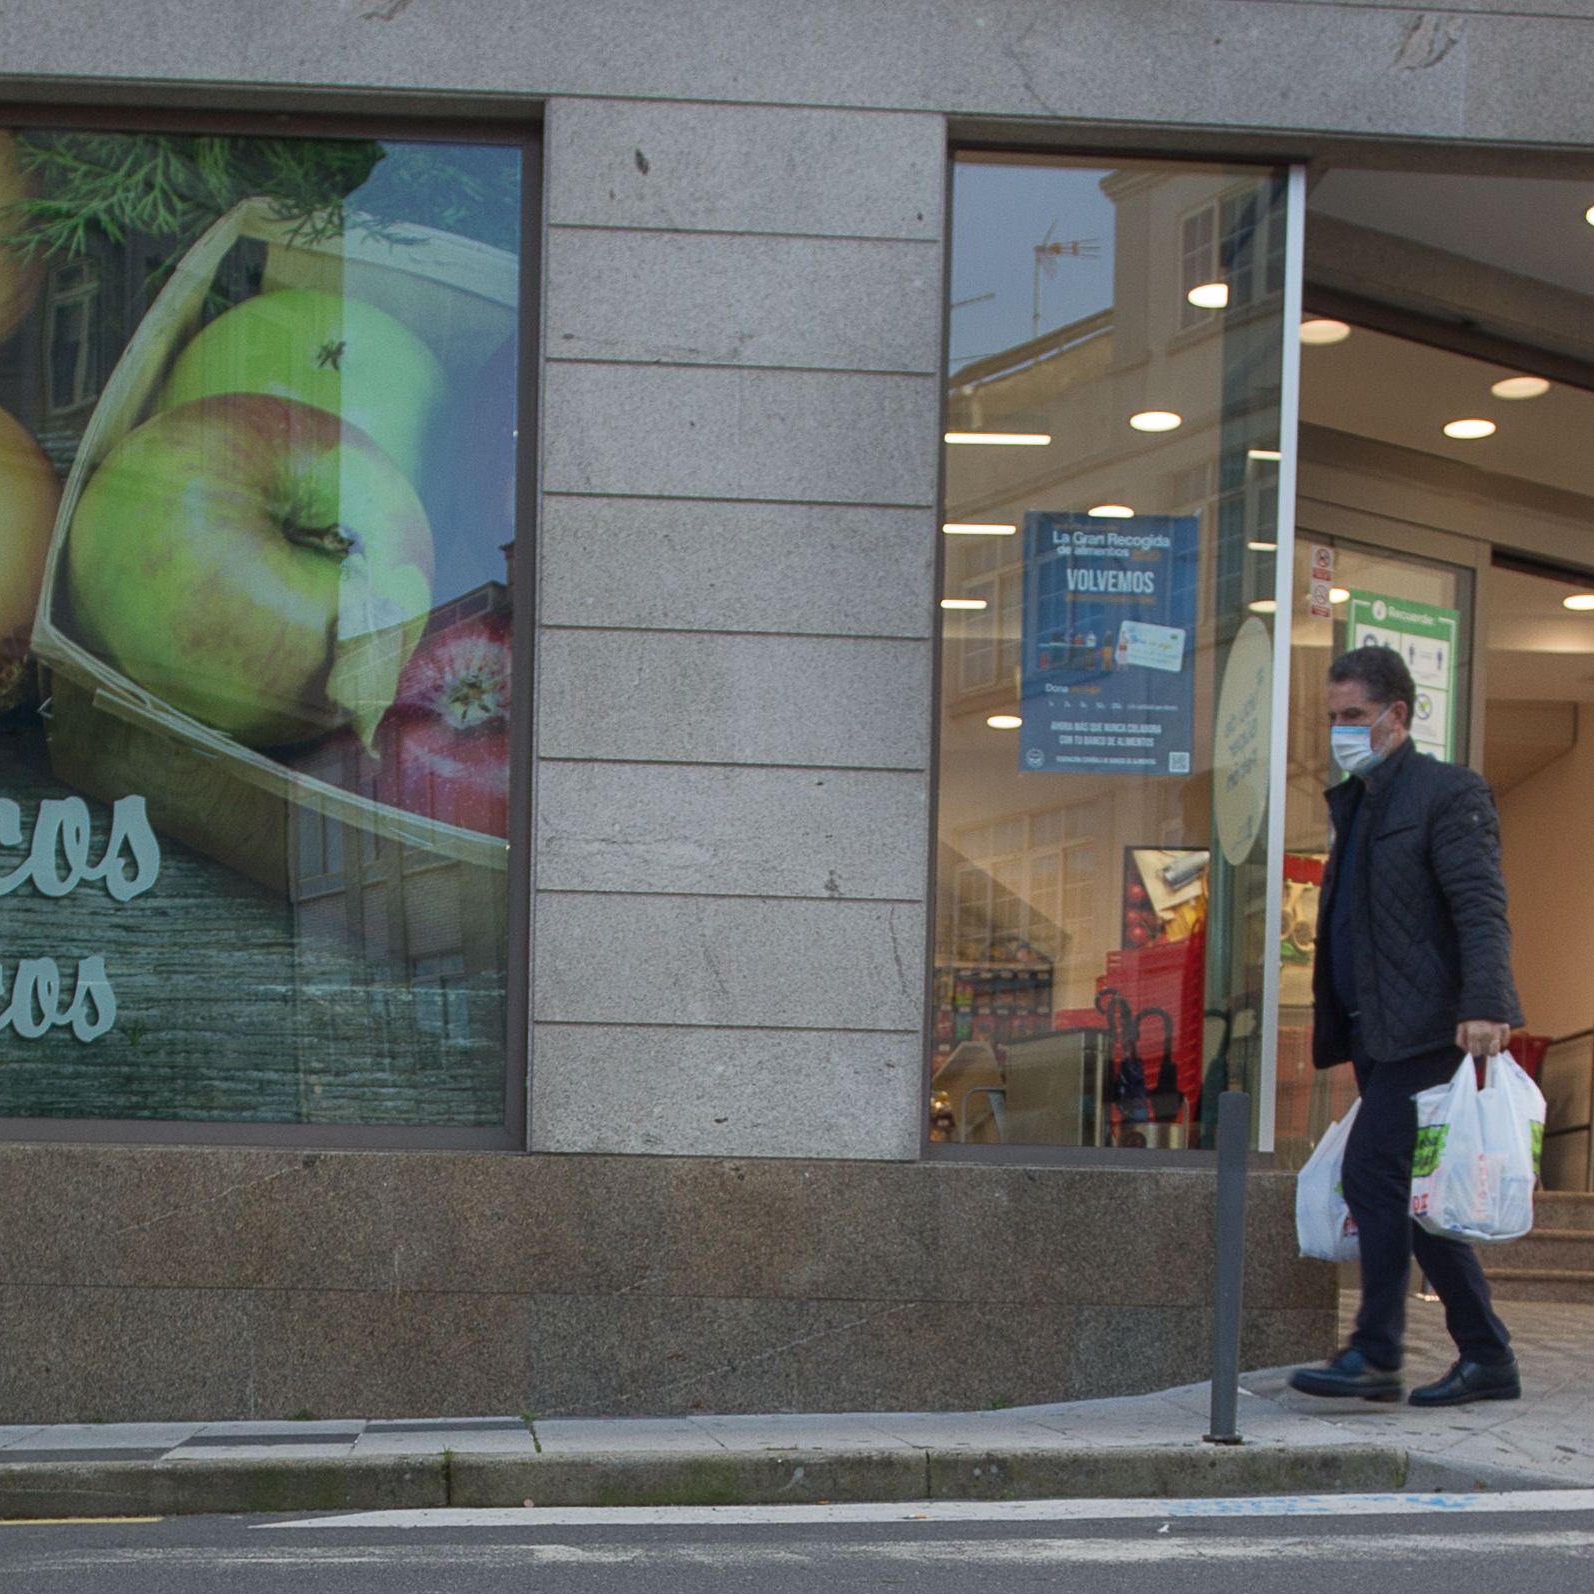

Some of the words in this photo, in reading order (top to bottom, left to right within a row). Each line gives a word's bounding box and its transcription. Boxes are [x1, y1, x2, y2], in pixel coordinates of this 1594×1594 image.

[1052, 530, 1070, 544] La
[1073, 531, 1105, 546] Gran
[1107, 533, 1171, 551] Recogida
[1056, 545, 1072, 555] de
[1074, 546, 1129, 557] alimentos
[1066, 568, 1155, 593] VOLVEMOS
[1045, 683, 1068, 693] Dona
